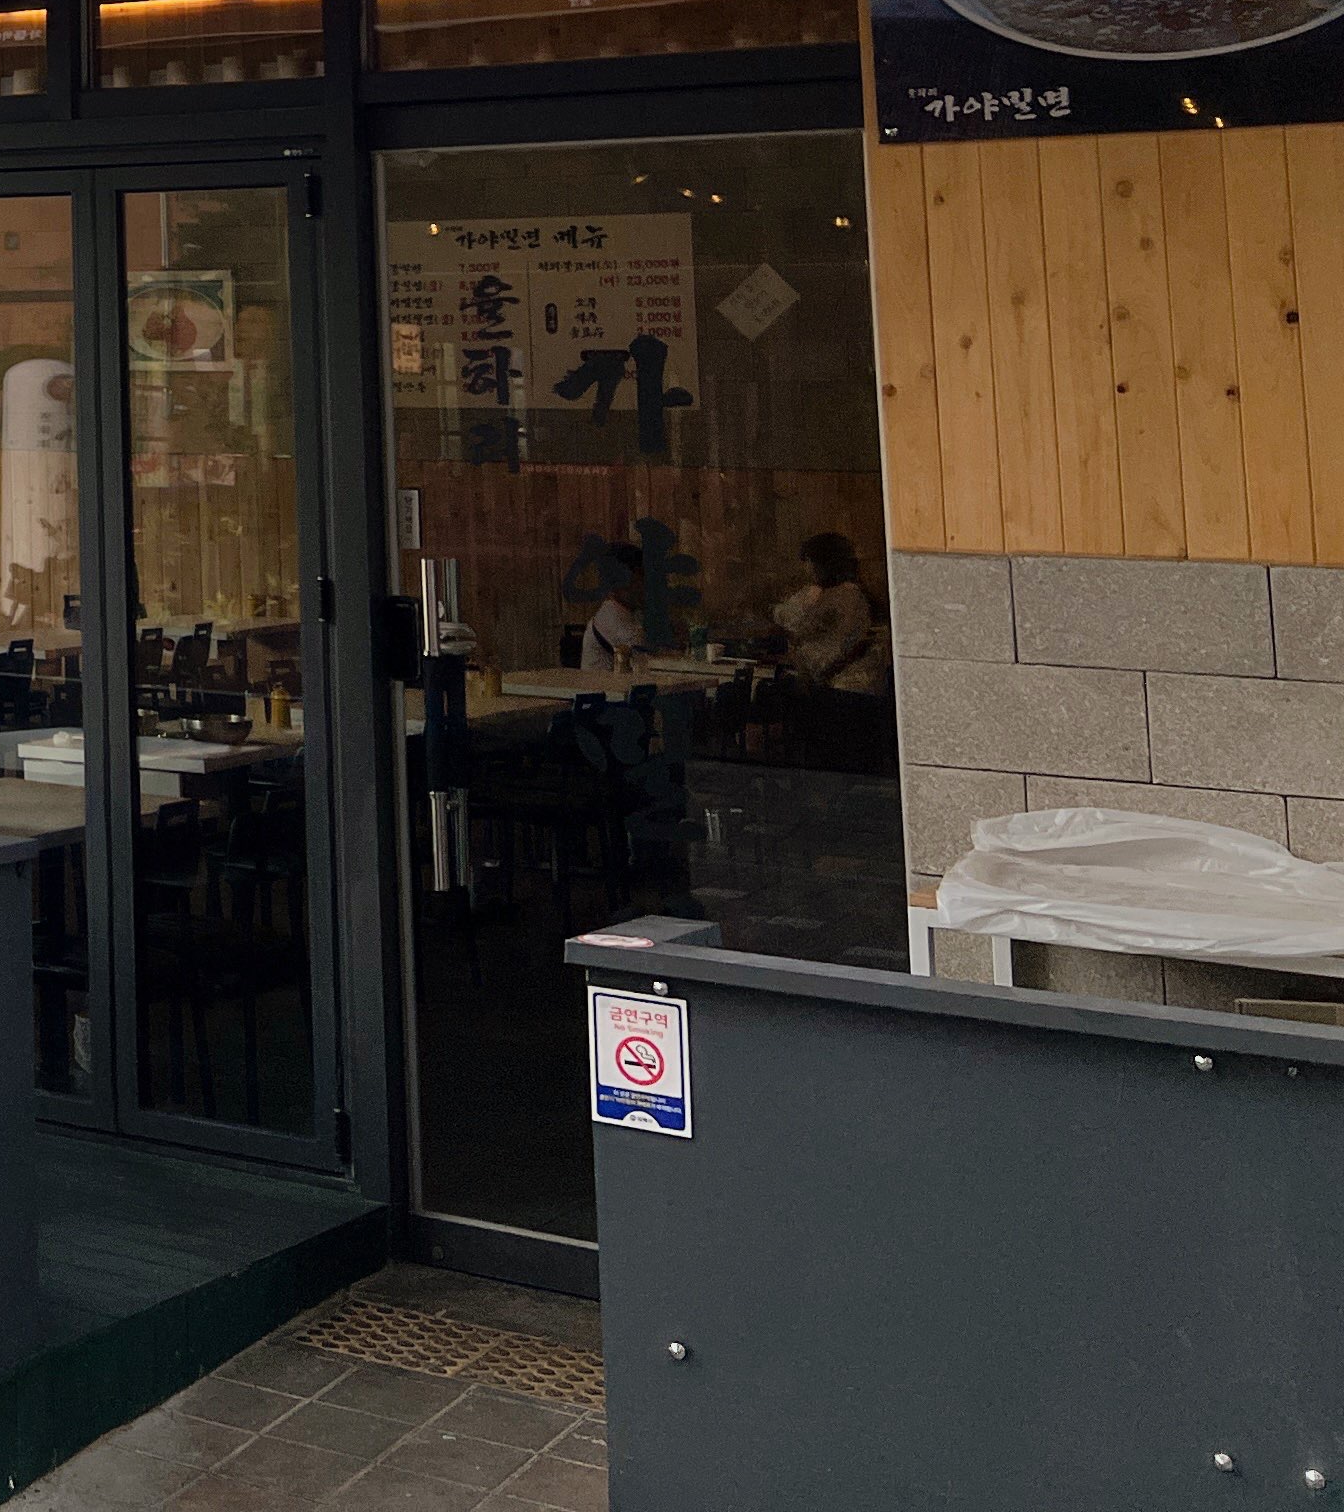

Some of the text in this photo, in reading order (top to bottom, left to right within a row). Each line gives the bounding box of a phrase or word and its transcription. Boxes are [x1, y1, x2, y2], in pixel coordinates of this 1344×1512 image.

[924, 86, 1071, 122] 가야밀면
[455, 225, 609, 250] 가야밀면 메뉴
[461, 275, 522, 474] 율하리
[609, 1006, 668, 1029] 금연구역
